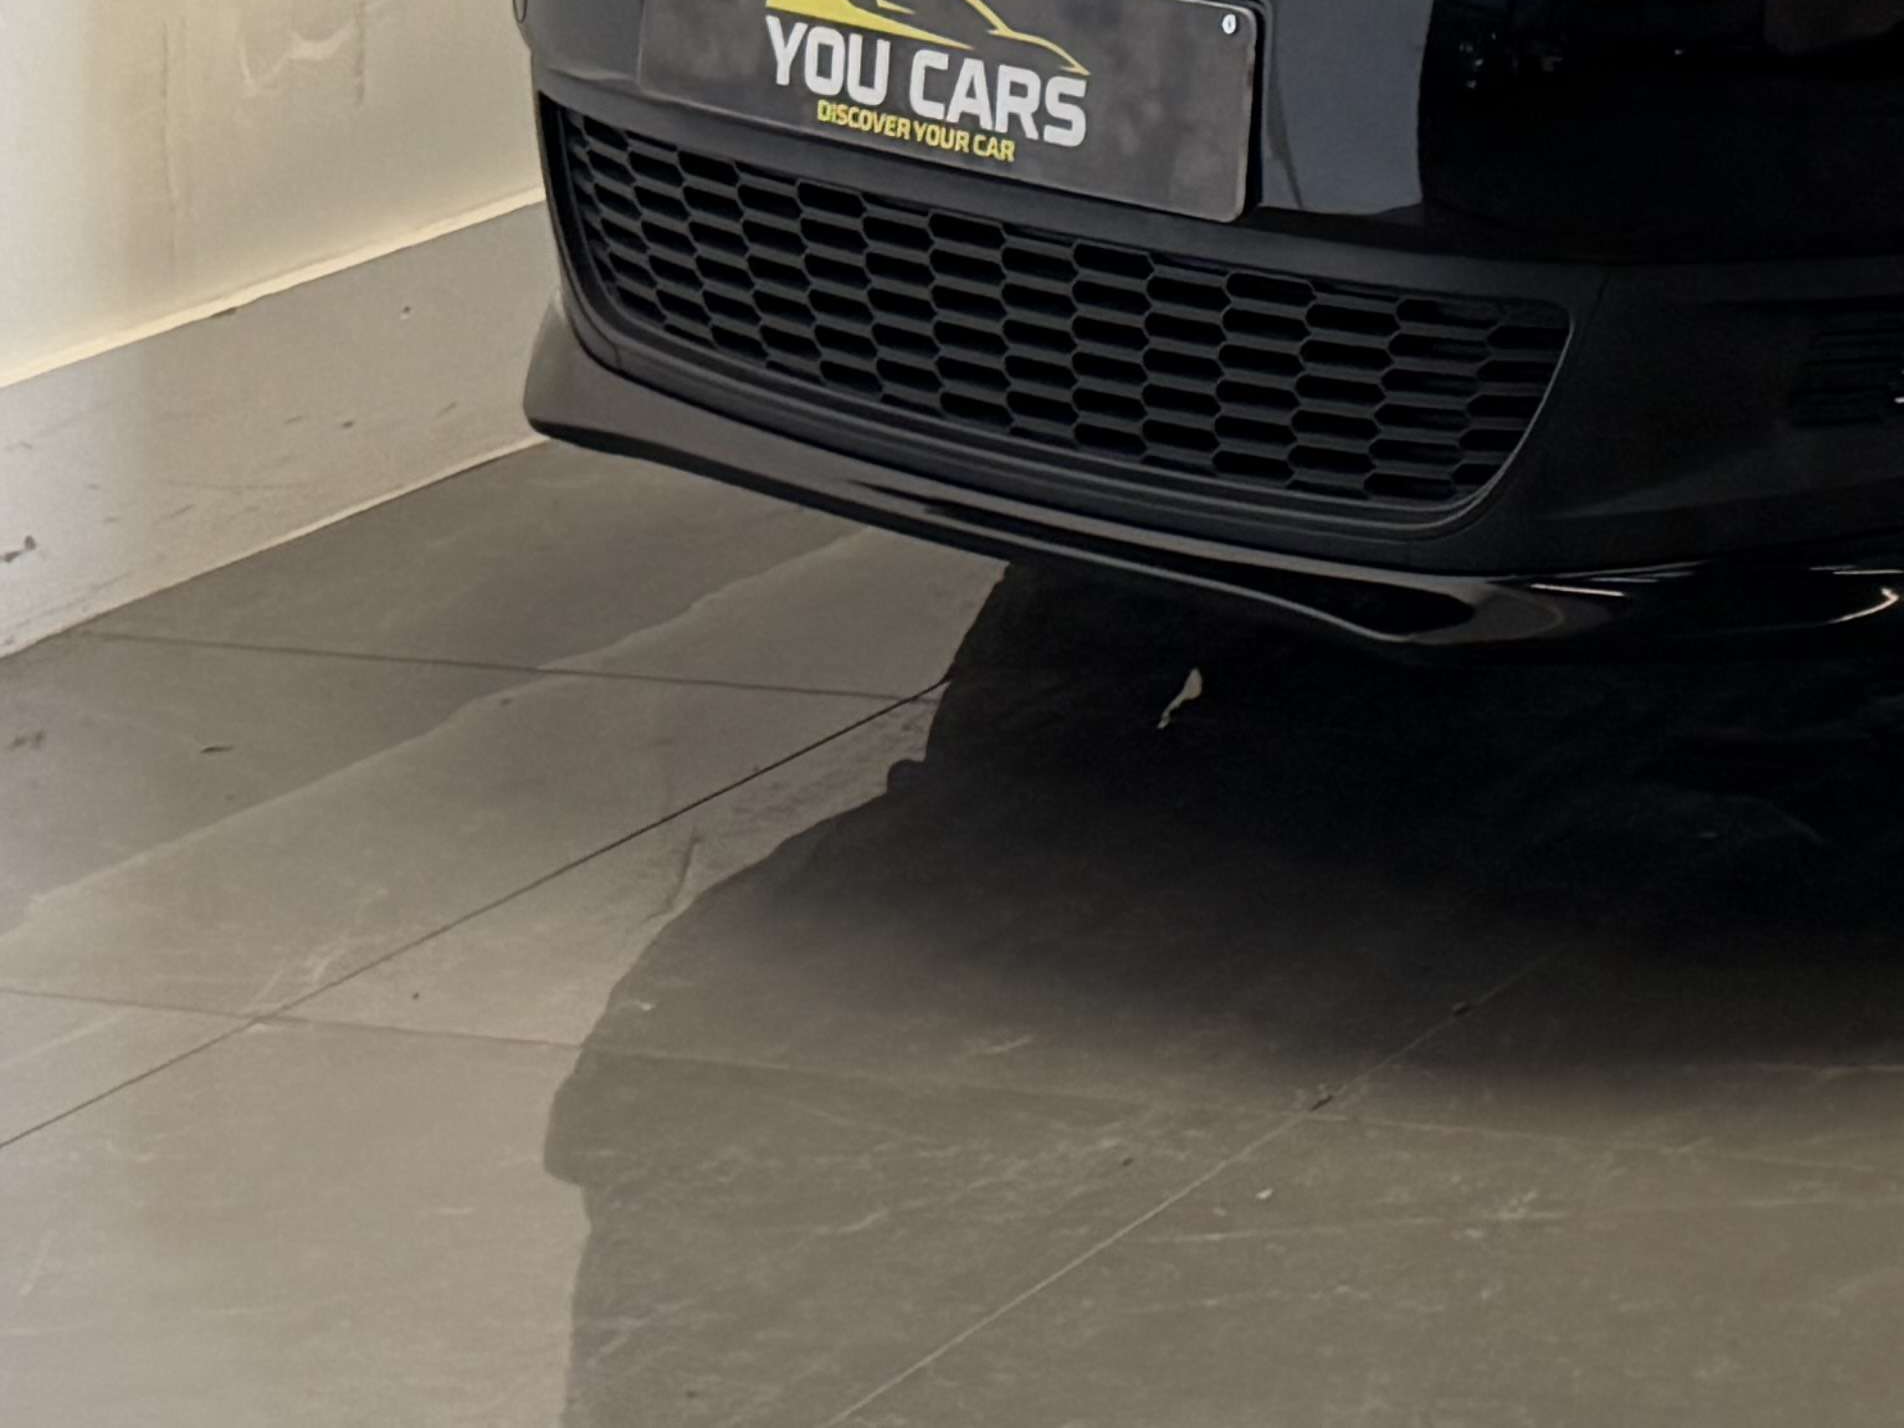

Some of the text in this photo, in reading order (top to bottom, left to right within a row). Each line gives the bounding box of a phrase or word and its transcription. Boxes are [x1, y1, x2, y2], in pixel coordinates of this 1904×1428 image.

[765, 15, 1087, 147] YOU CARS
[913, 121, 970, 154] YOUR
[972, 134, 1016, 164] CAR
